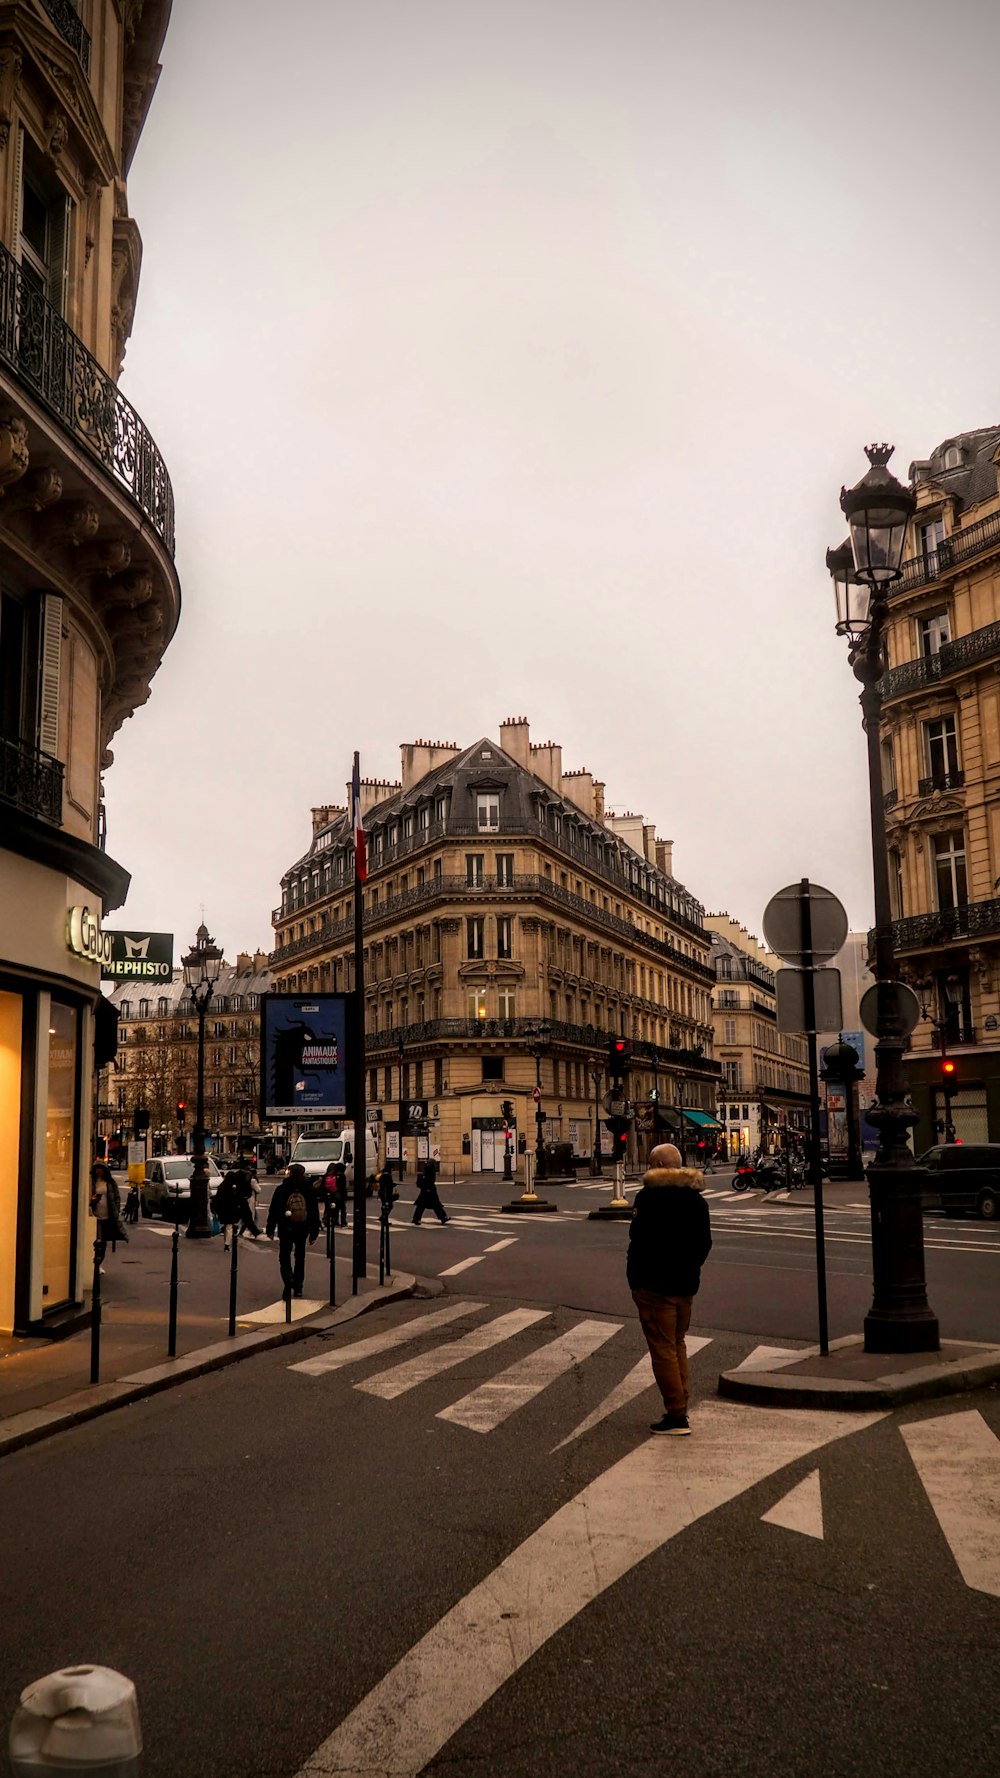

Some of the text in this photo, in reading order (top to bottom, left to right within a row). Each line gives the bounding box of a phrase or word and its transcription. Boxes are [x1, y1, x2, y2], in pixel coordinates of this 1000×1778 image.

[103, 961, 170, 976] MEPHISTO
[302, 1046, 337, 1057] ANIMAUX
[302, 1057, 337, 1065] FANTASTIQUES
